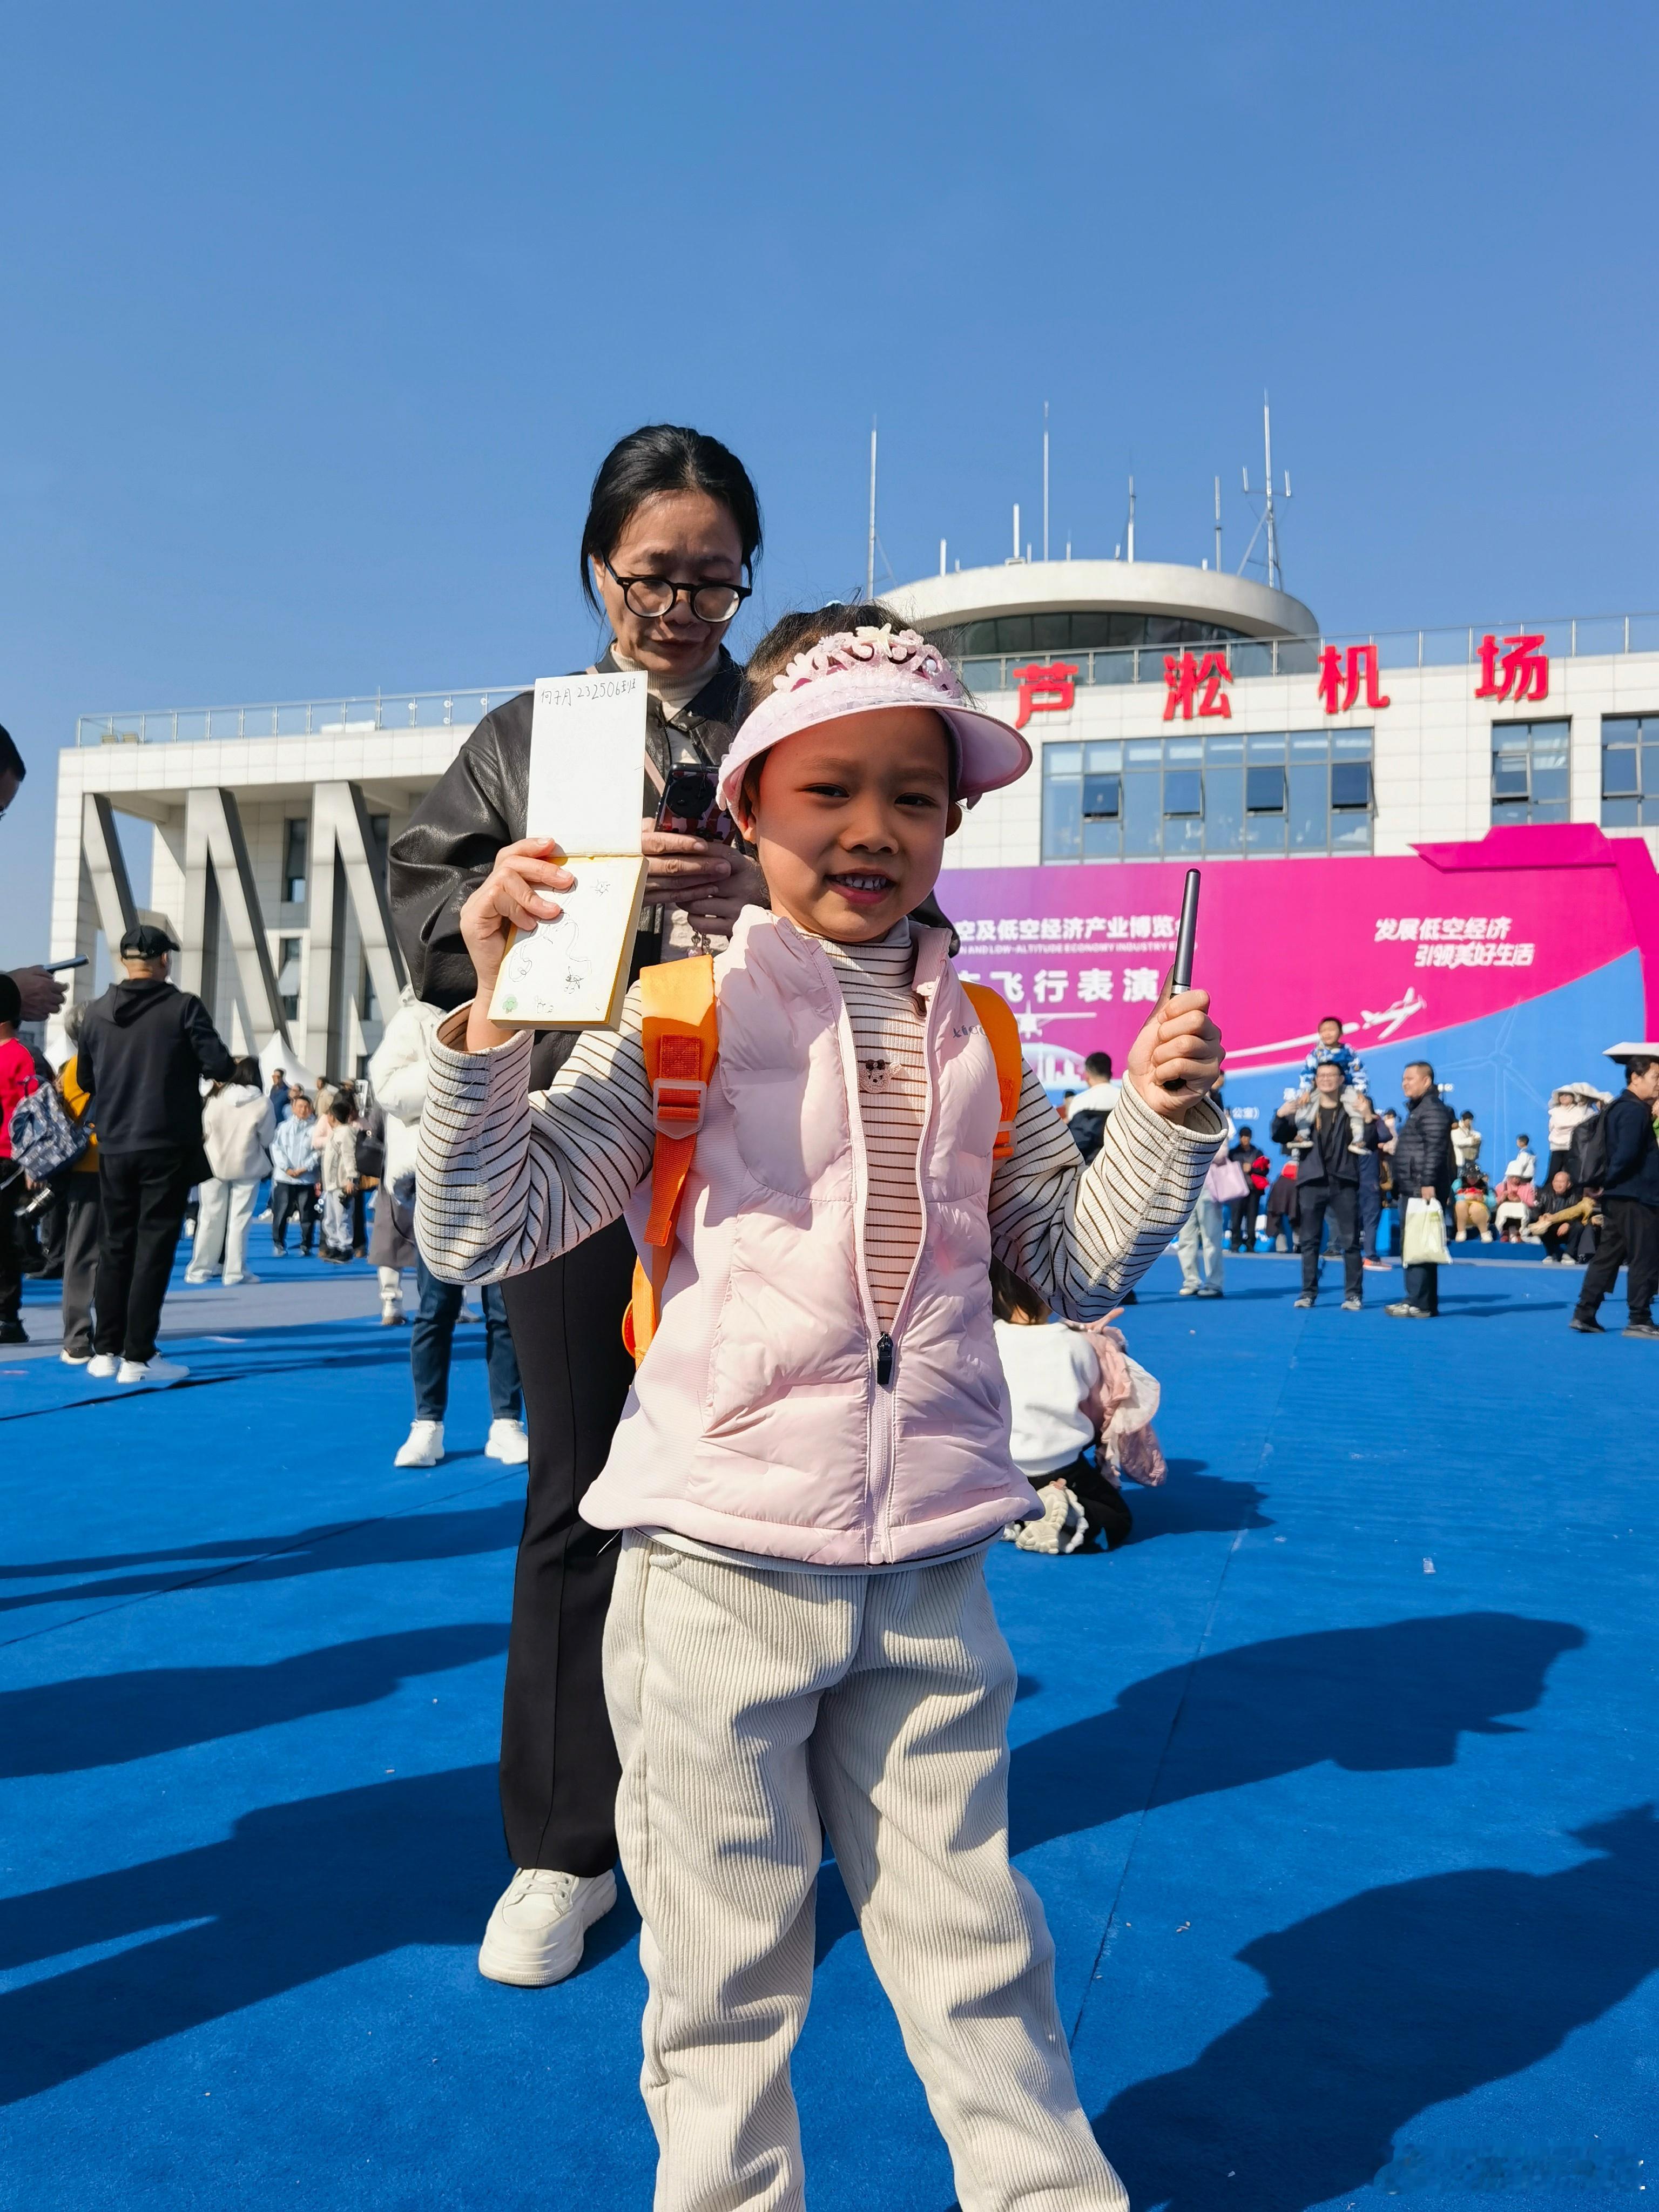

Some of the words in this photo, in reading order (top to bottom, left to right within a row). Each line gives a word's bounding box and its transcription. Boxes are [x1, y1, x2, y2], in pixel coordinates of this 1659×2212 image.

[1013, 634, 1549, 729] 芦淞机场
[956, 915, 1181, 941] 空及低空经济产业博览
[1374, 916, 1512, 942] 发展低空经济
[1414, 941, 1535, 969] 引领美好生活
